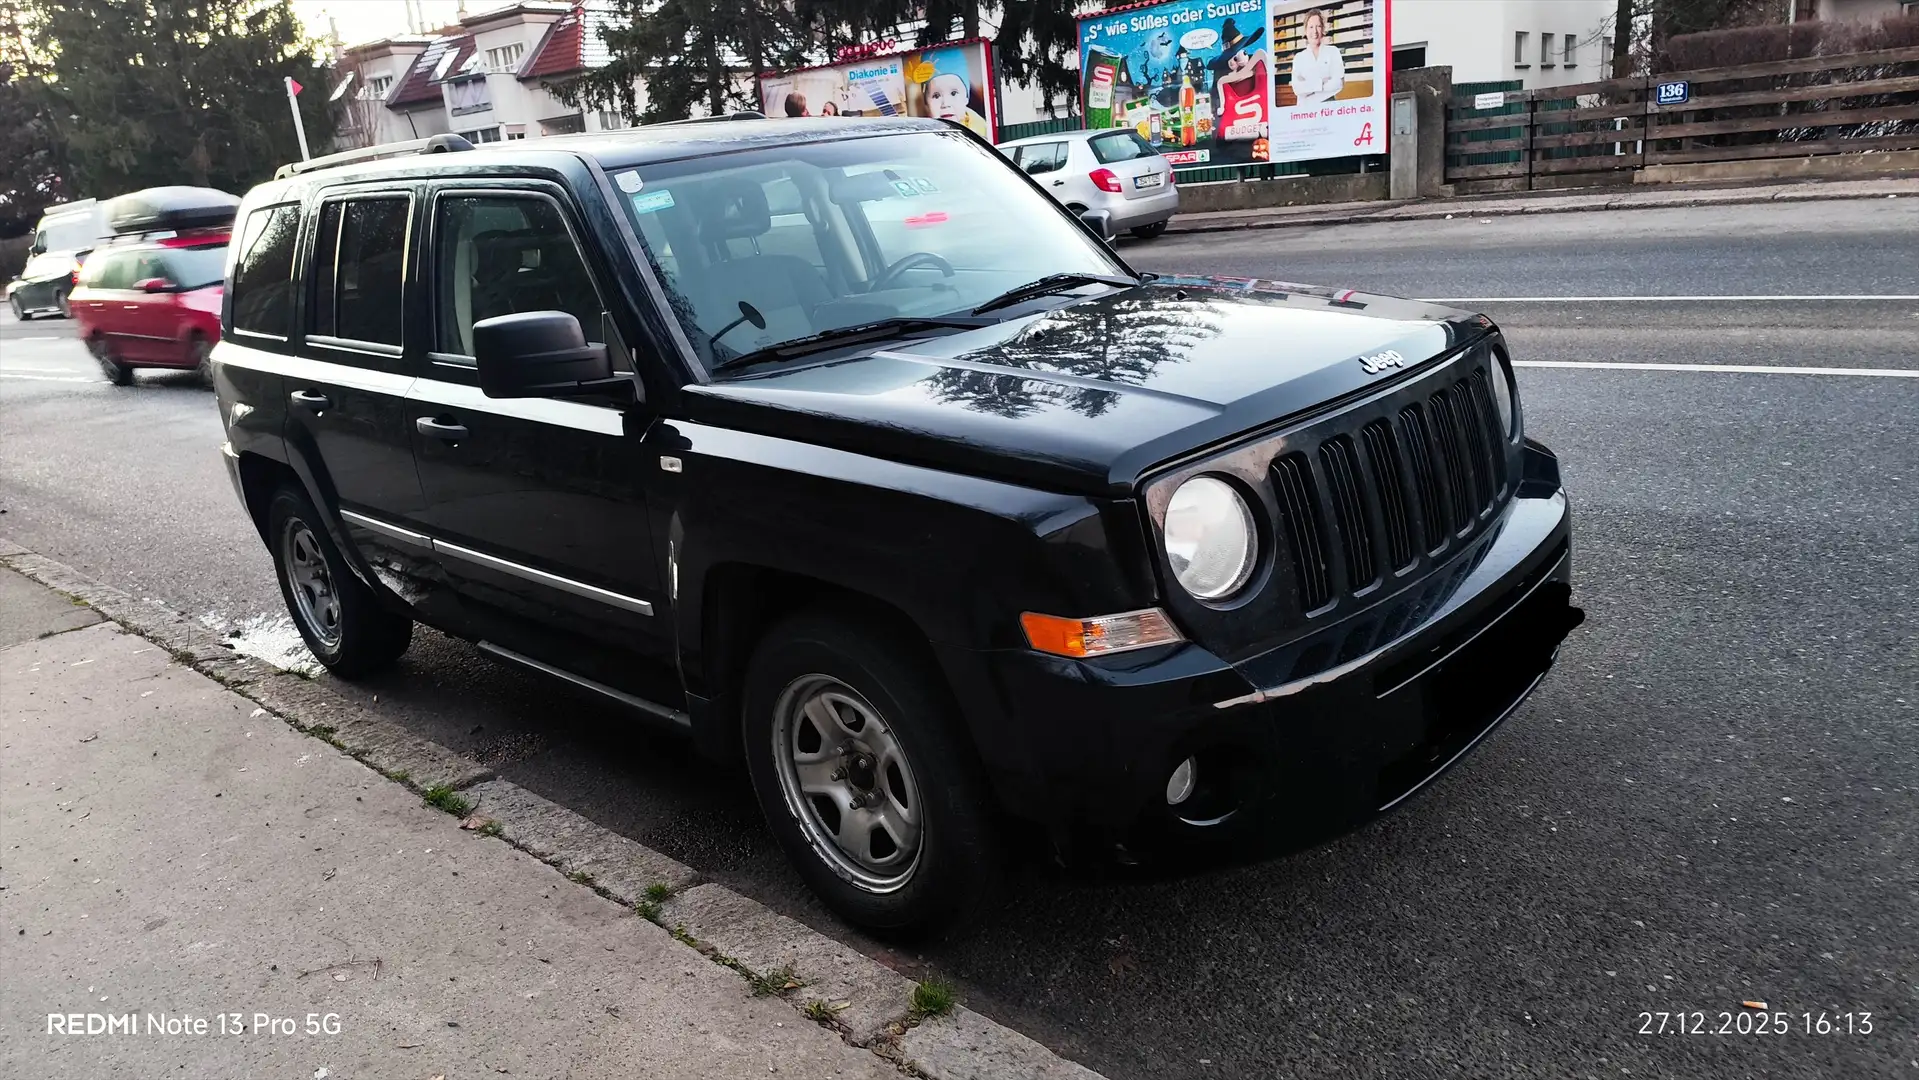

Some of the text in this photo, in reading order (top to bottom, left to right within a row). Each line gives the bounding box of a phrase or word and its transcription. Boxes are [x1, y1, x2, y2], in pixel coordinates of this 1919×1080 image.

[1105, 20, 1128, 37] wie
[1131, 13, 1169, 32] Süßes
[1172, 9, 1204, 26] oder
[1206, 0, 1262, 19] Saures!
[849, 66, 888, 80] Diakonie
[1660, 84, 1684, 98] 136
[1290, 104, 1374, 121] immer für dich da.
[1230, 124, 1263, 136] BUDGET
[1165, 152, 1196, 163] SPAR
[1359, 349, 1404, 375] Jeep
